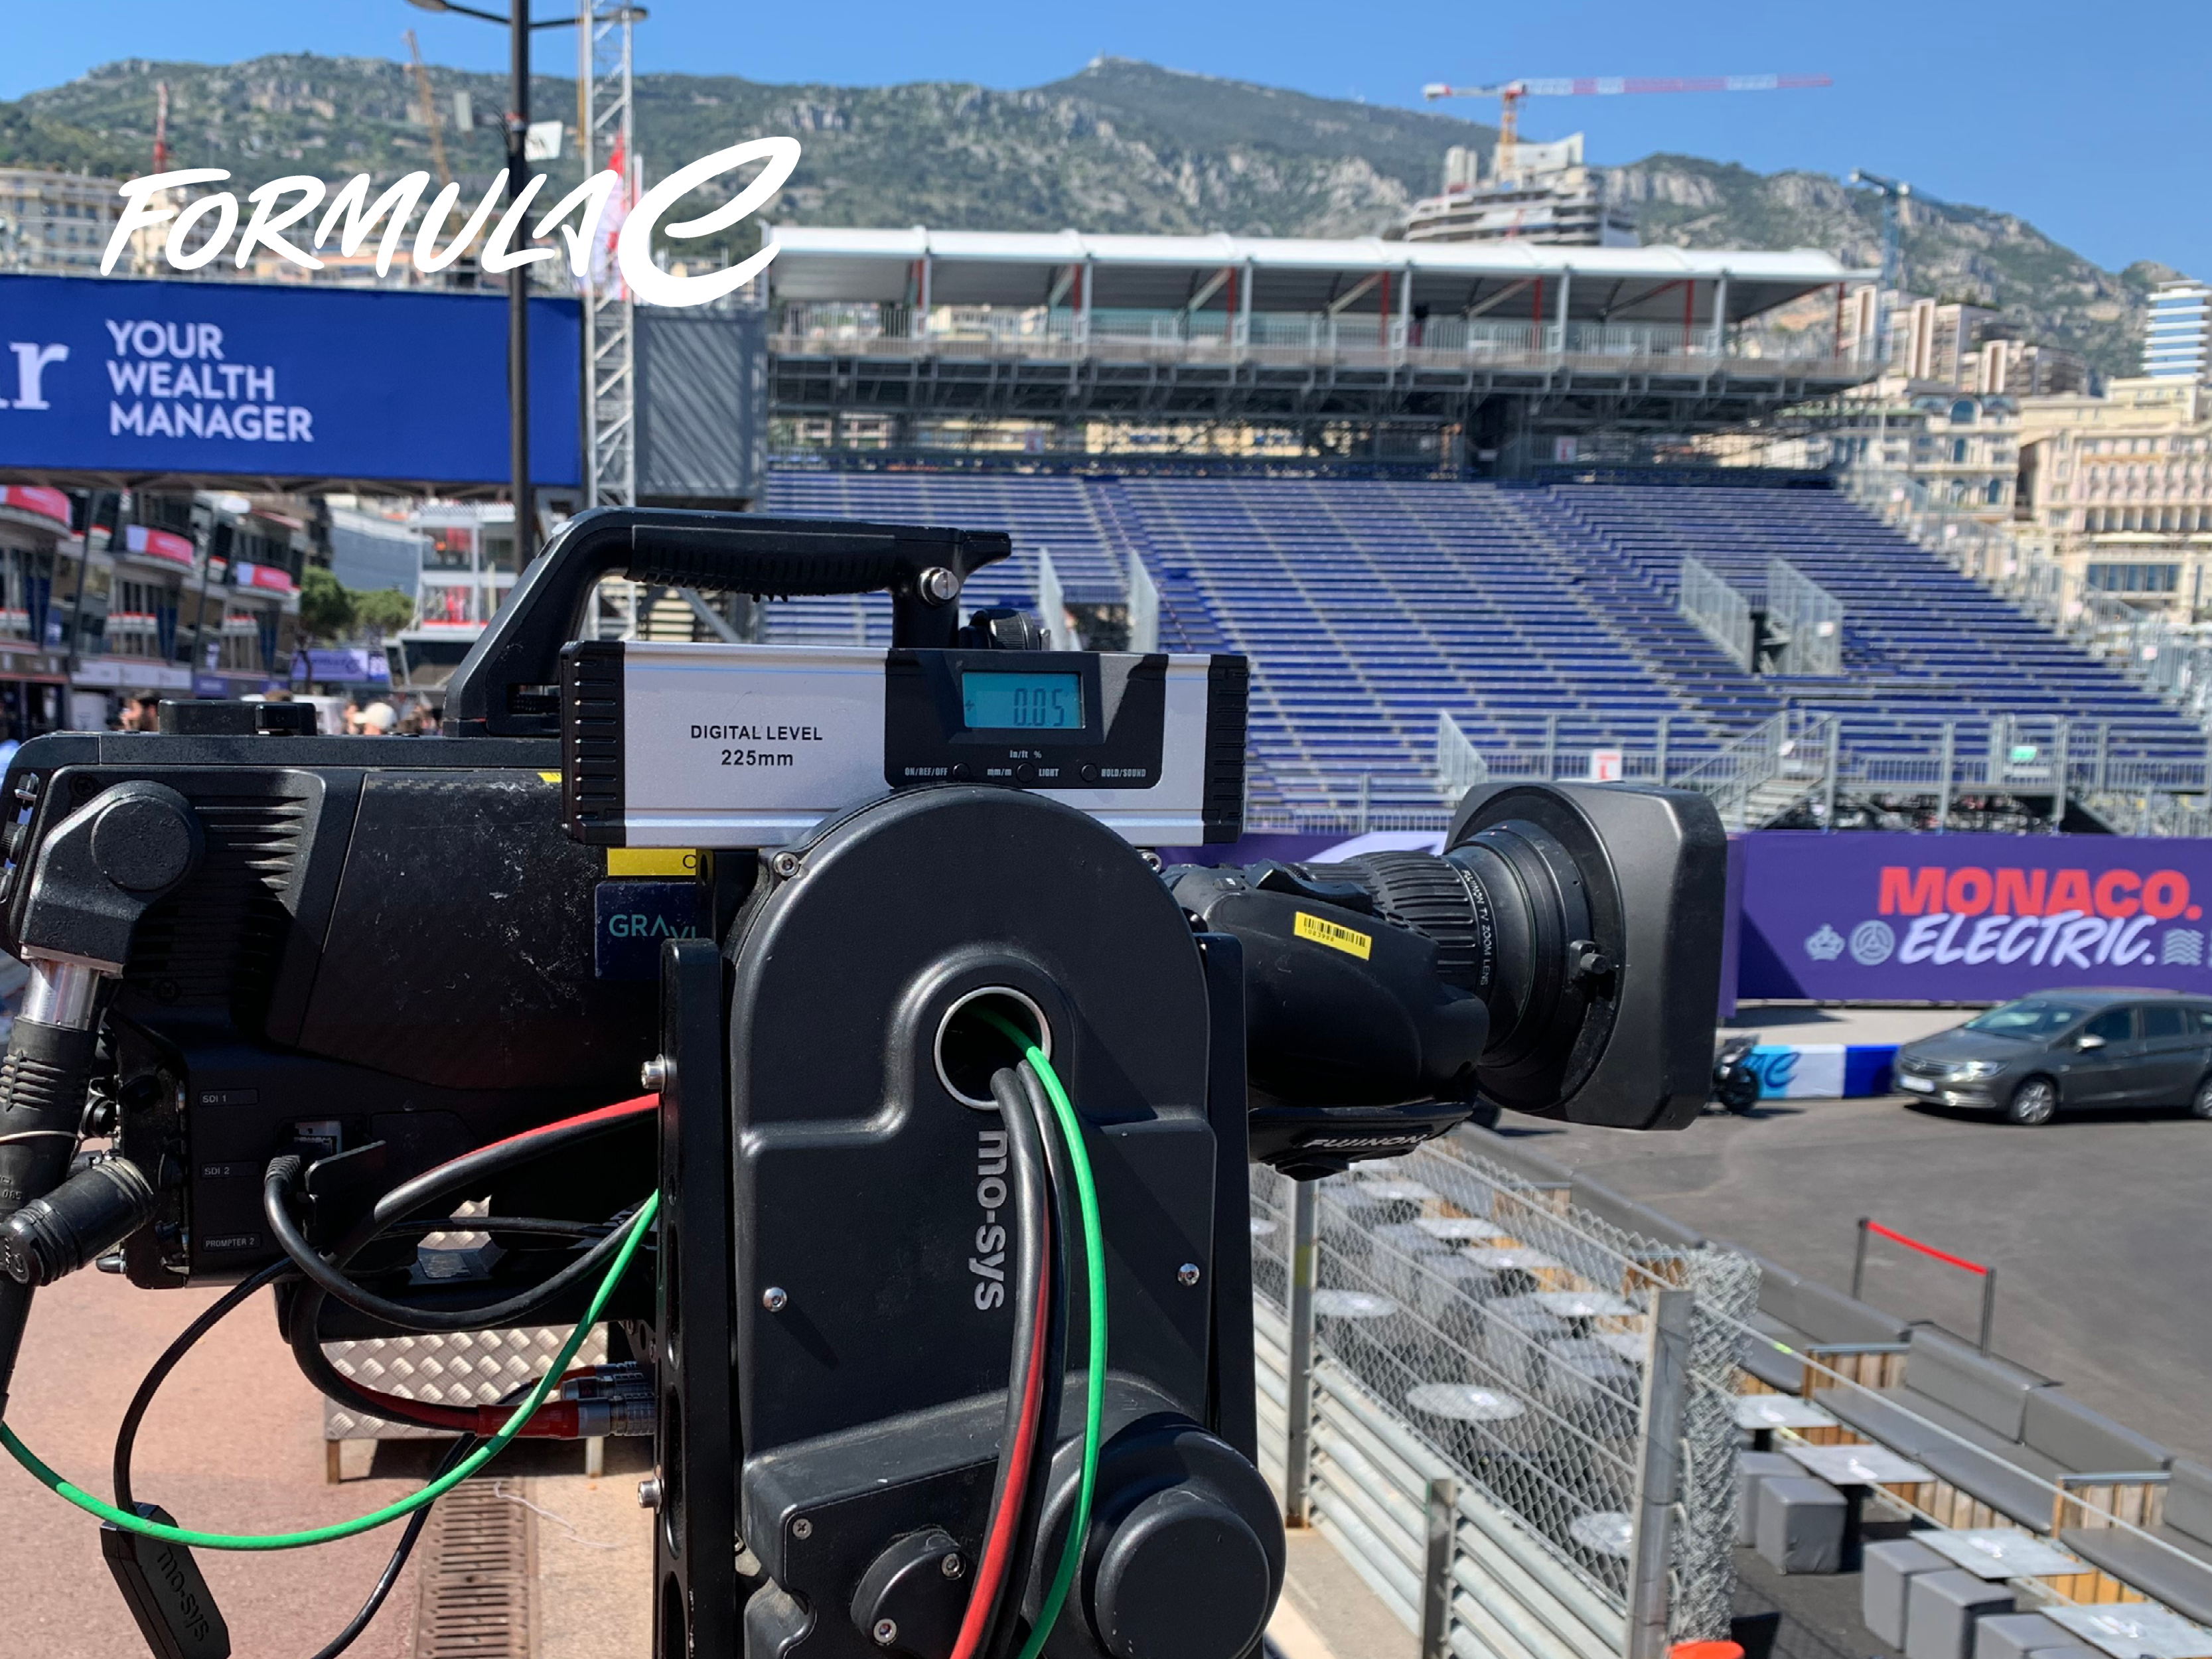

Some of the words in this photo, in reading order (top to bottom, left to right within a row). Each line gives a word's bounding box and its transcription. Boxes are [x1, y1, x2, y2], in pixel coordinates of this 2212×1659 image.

[105, 319, 224, 360] YOUR
[106, 360, 275, 401] WEALTH
[109, 399, 315, 443] MANAGER
[1013, 687, 1065, 727] 0.05
[690, 725, 762, 741] DIGITAL
[767, 725, 824, 741] LEVEL
[721, 749, 794, 766] 225mm
[1038, 768, 1060, 777] LIGHT
[1100, 768, 1147, 778] HOLD/SOUND
[1878, 866, 2203, 921] MONACO.
[1479, 907, 1489, 921] TV
[1482, 924, 1493, 956] ZOOM
[1897, 909, 2158, 970] ELECTRIC.
[1480, 959, 1491, 986] LENS
[202, 1094, 219, 1103] SDI
[1302, 1133, 1428, 1148] FUJINON
[204, 1167, 221, 1175] SDI
[224, 1166, 230, 1175] 2
[968, 1130, 1008, 1311] mo-sys
[205, 1238, 247, 1248] PROMPTER
[157, 1546, 210, 1642] mo-sys
